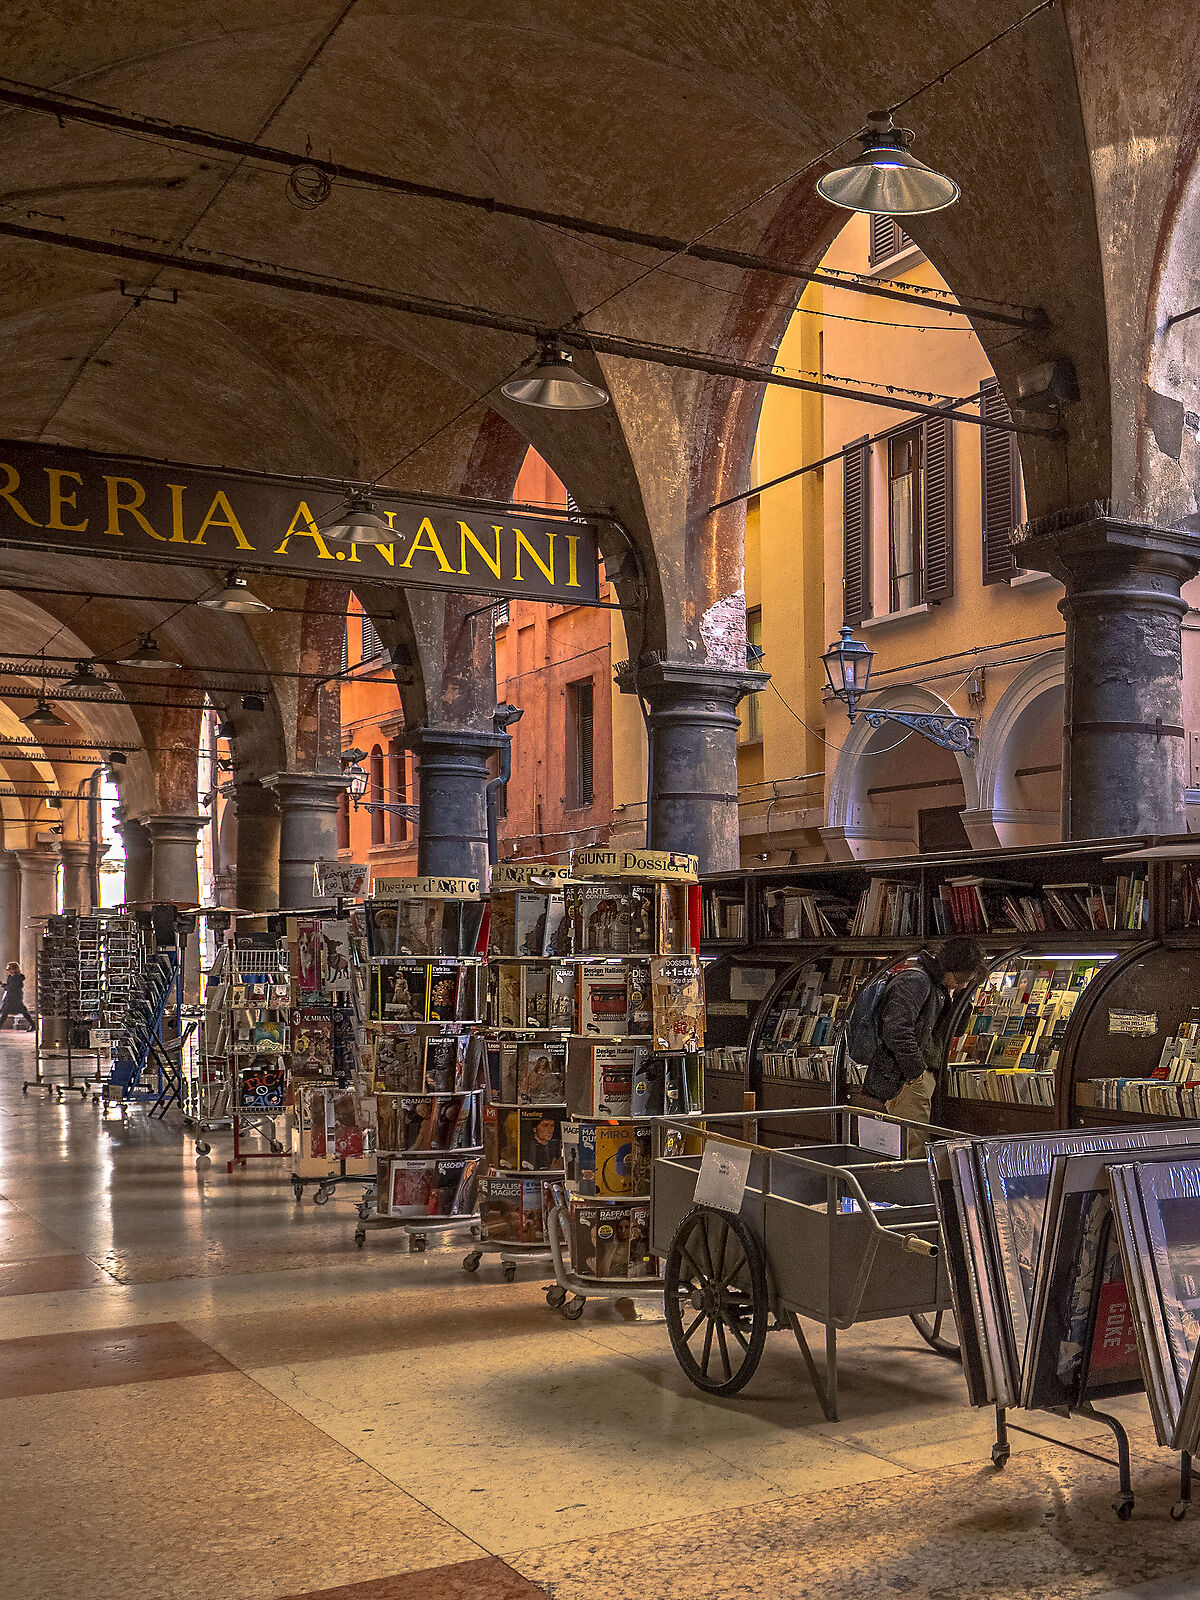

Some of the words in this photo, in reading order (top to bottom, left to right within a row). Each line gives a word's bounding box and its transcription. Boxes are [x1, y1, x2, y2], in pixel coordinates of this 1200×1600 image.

[578, 853, 615, 864] GIUNTI
[378, 880, 420, 893] Dossier
[586, 887, 610, 895] ARTE
[1103, 1303, 1127, 1348] COKE
